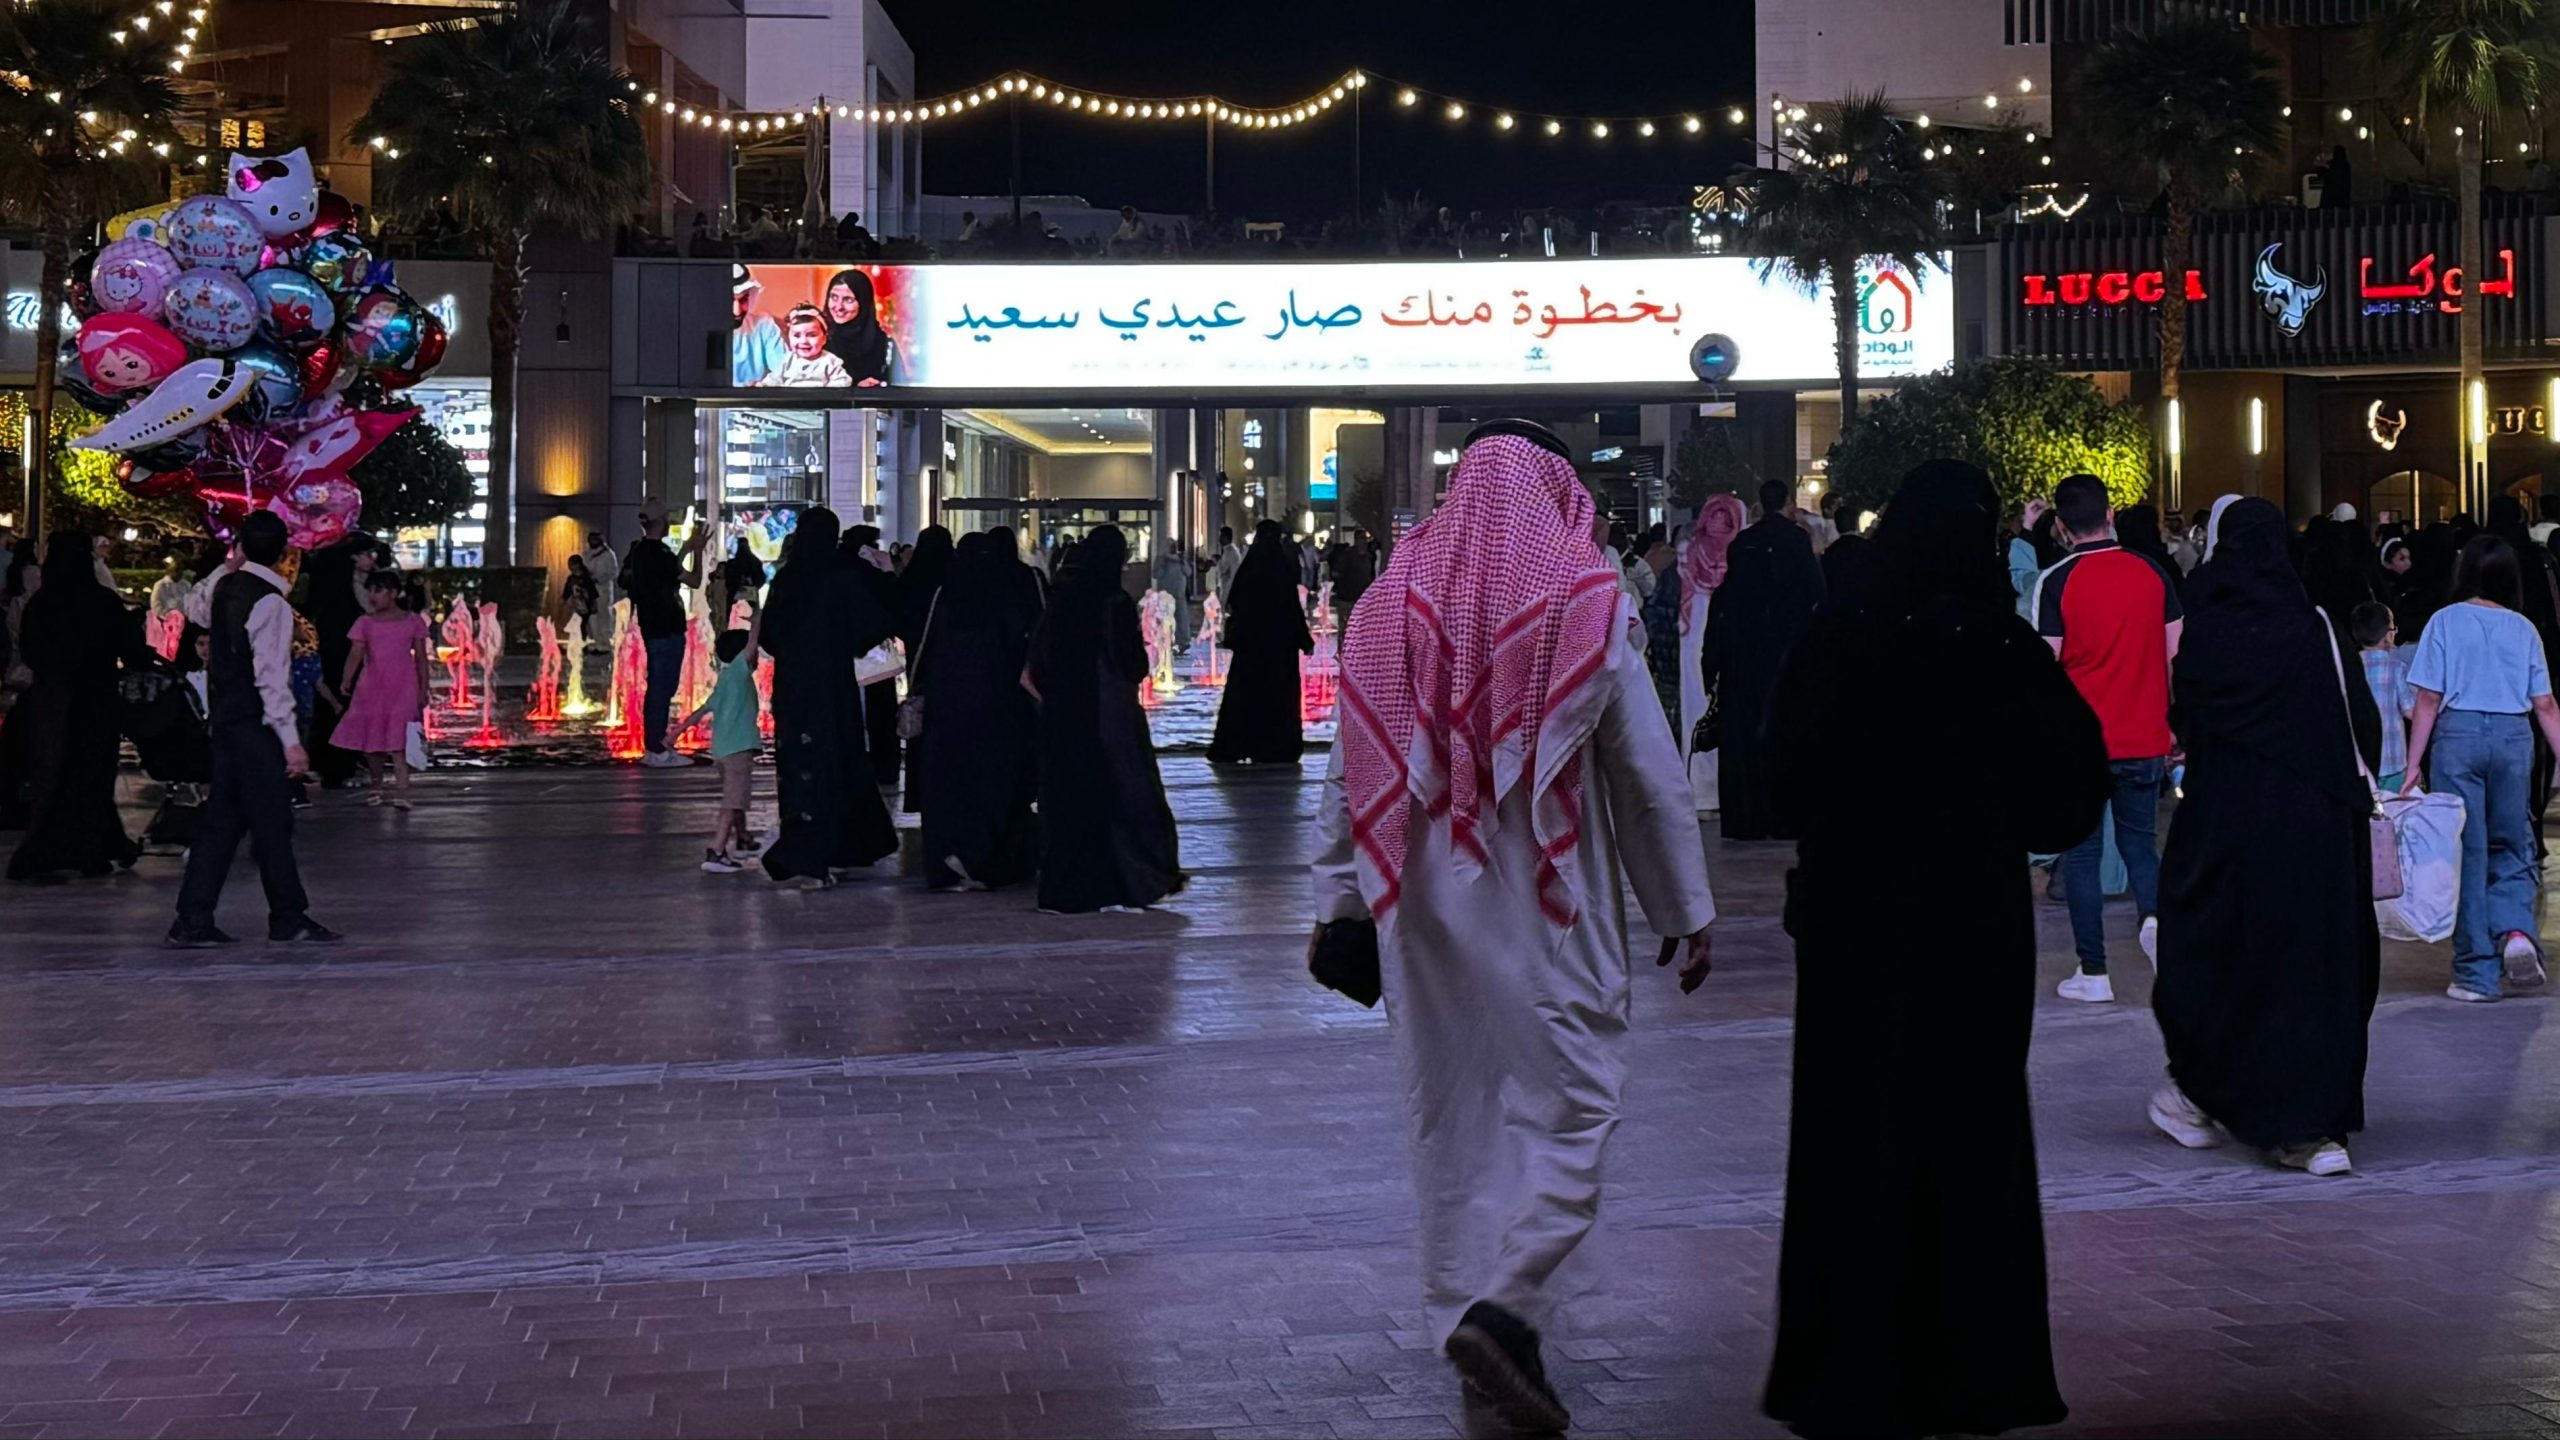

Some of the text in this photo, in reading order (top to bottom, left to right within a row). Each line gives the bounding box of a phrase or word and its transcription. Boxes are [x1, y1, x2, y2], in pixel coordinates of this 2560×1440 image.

[947, 285, 1681, 342] بخطوة منك صار عيدي سعيد
